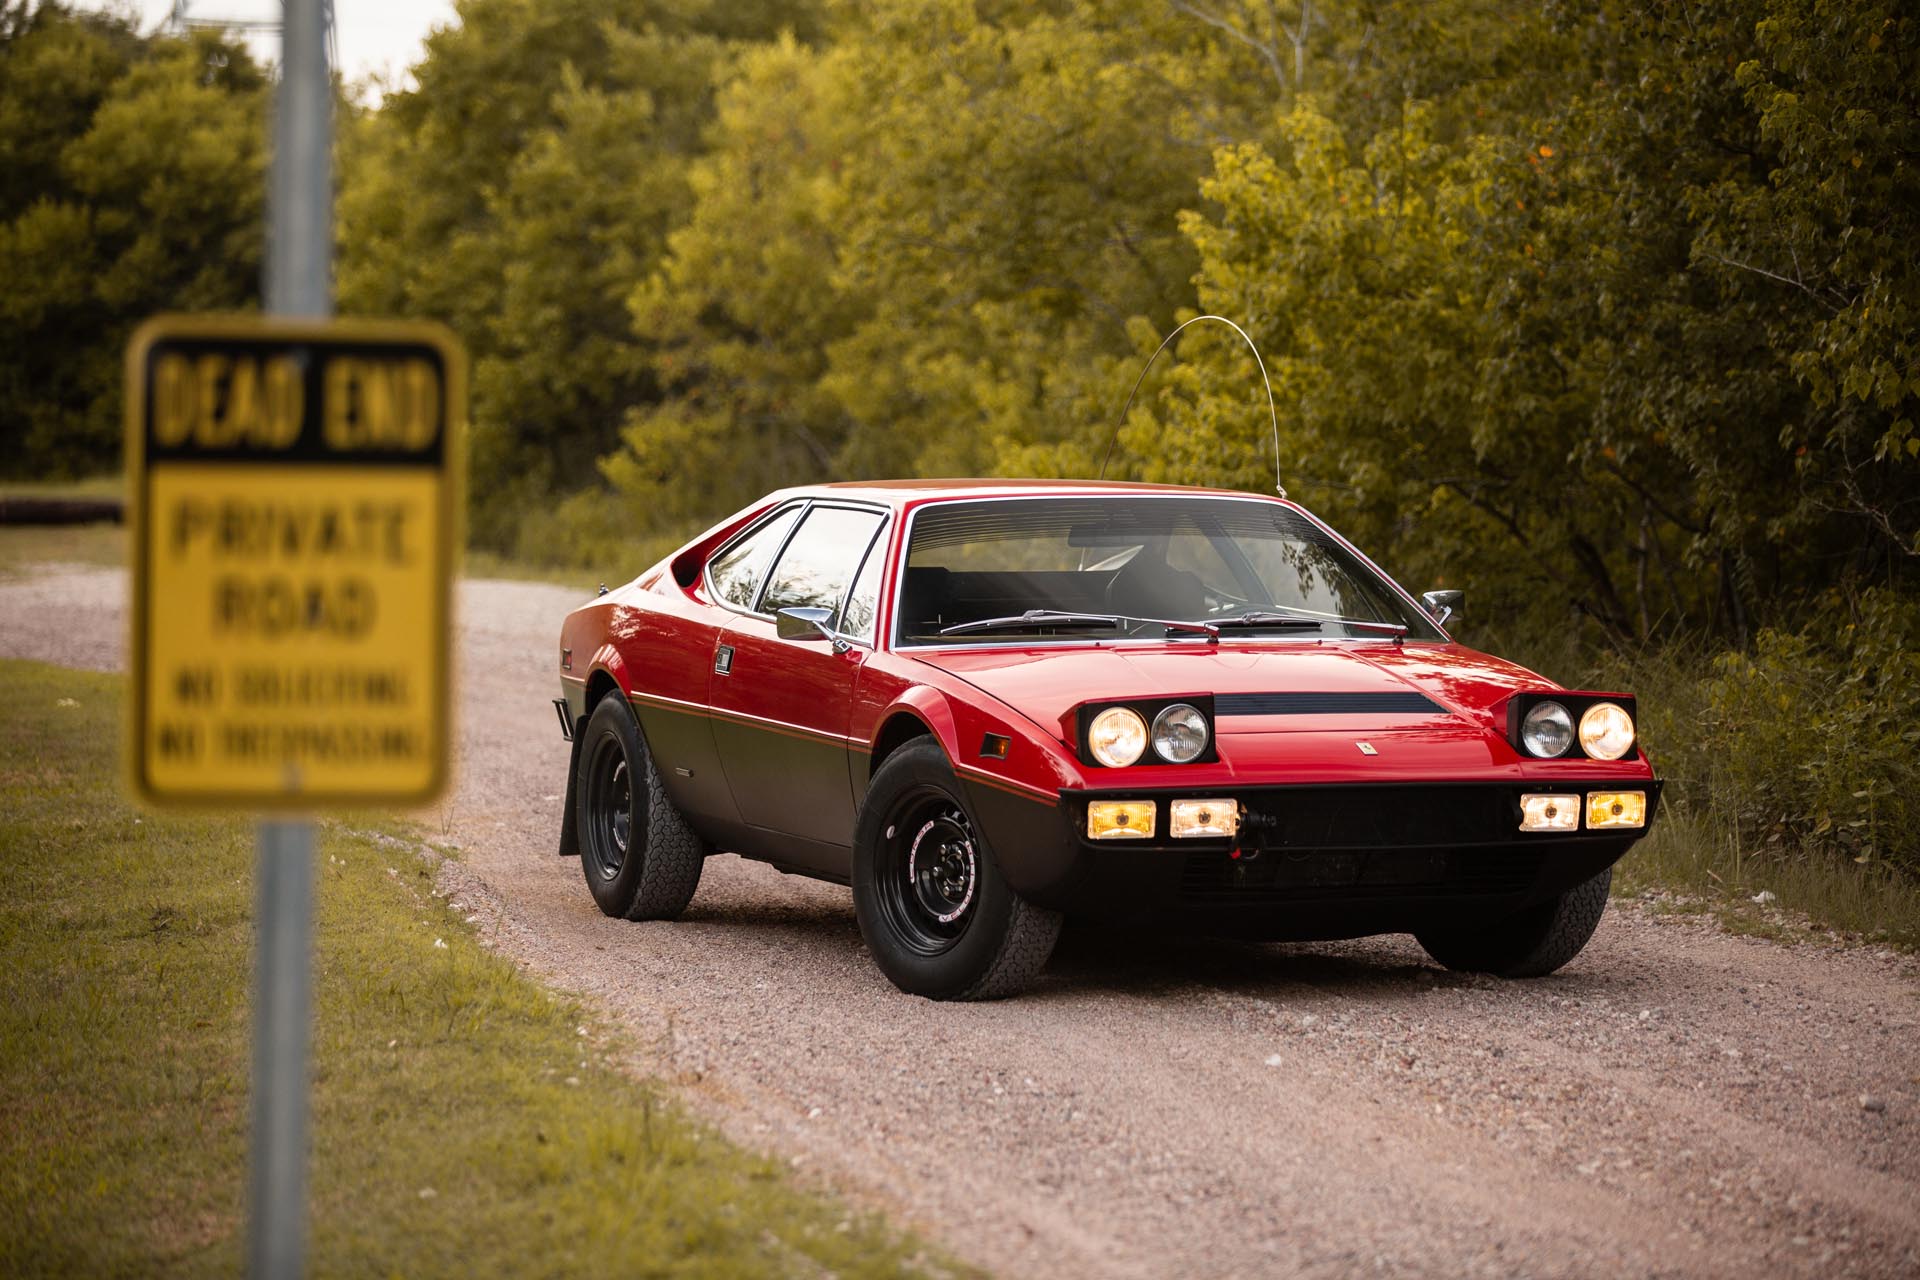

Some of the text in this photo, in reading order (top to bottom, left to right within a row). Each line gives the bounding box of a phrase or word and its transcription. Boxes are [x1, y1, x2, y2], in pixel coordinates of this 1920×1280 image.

[154, 352, 441, 452] DEAD END
[171, 498, 422, 567] PRIVATE
[213, 575, 377, 643] ROAD
